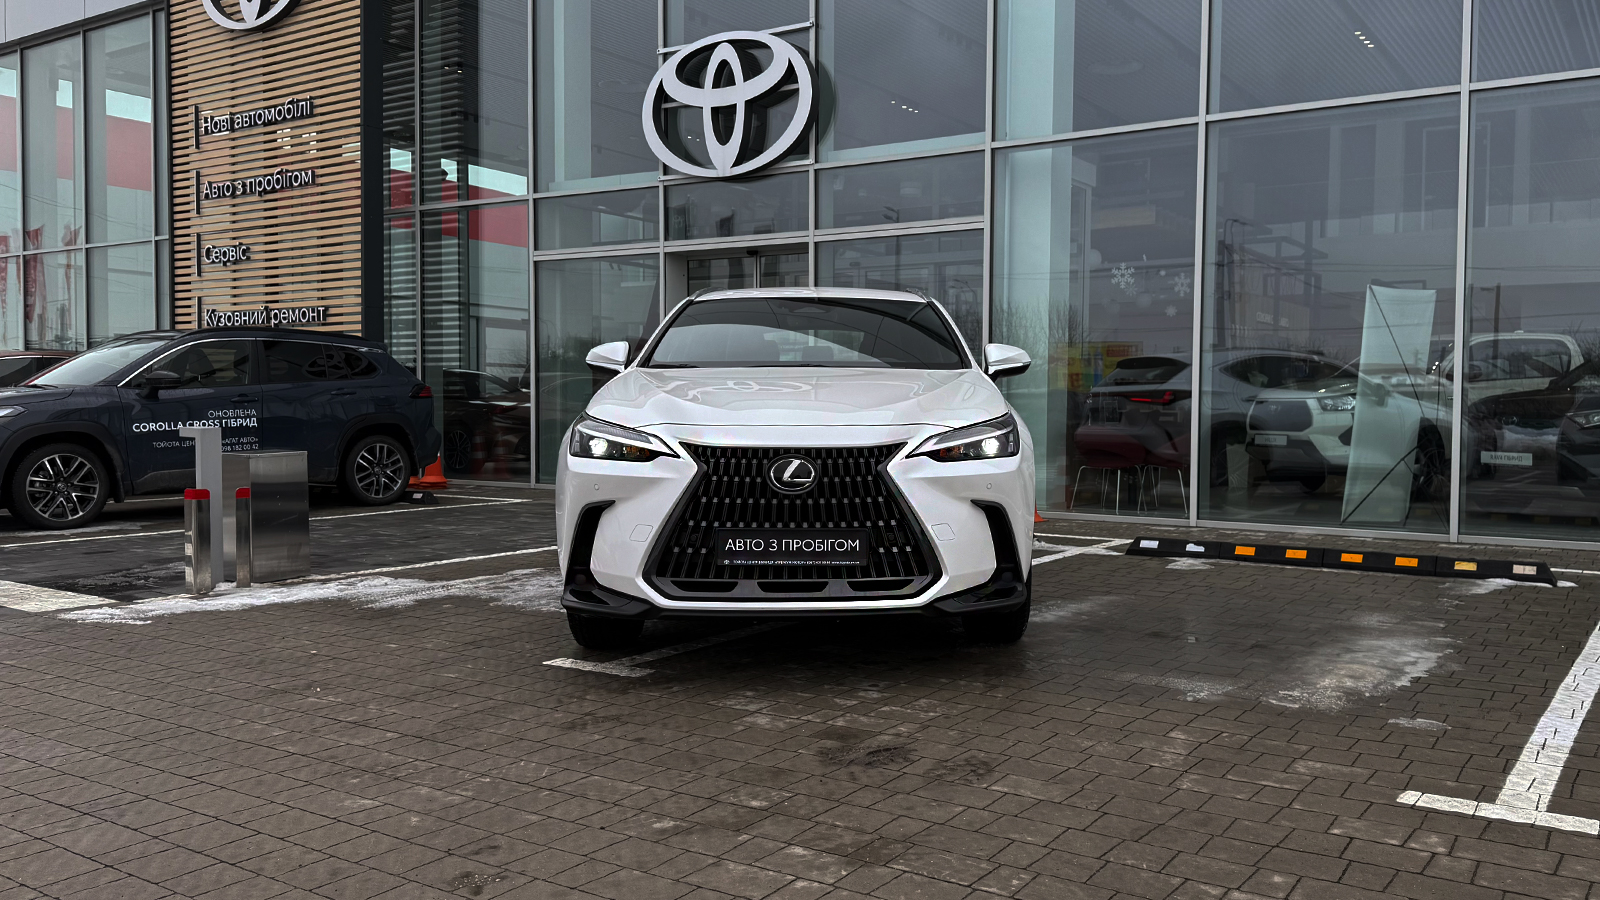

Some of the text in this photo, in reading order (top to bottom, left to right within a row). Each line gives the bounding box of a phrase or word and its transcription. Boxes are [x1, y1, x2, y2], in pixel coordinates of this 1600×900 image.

[203, 95, 310, 134] Нові автомобілі
[203, 168, 312, 199] Авто з пробігом
[204, 241, 248, 267] Сервіс
[205, 305, 325, 328] Кузовний ремонт
[132, 418, 258, 432] COROLLA CROSS ГІБРИД
[208, 409, 257, 418] ОНОВЛЕНА
[725, 539, 764, 551] АВТО
[782, 539, 860, 551] ПРОБІГОМ
